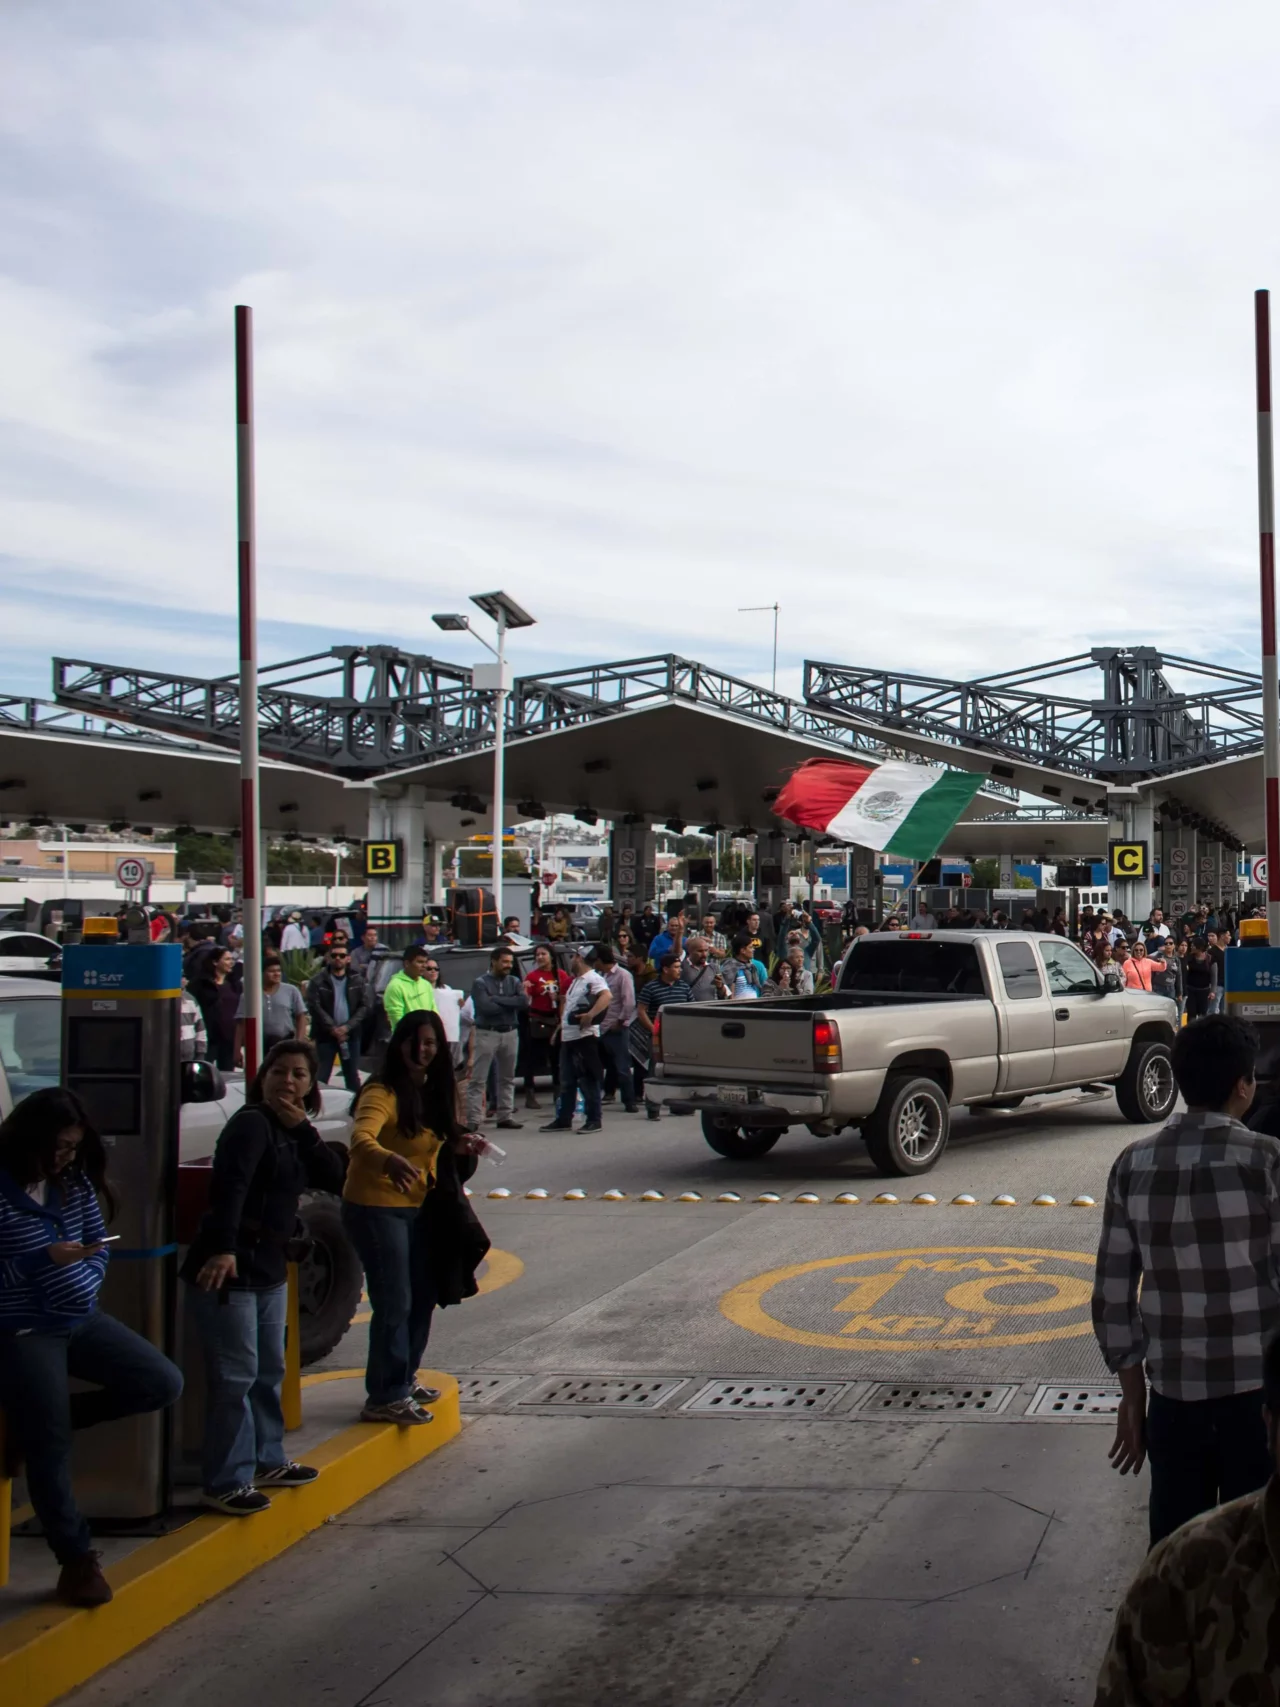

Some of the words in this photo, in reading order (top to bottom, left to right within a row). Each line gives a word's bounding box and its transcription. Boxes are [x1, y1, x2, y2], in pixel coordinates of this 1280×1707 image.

[371, 848, 392, 870] B
[1117, 848, 1139, 872] C
[123, 865, 138, 876] 10
[99, 974, 124, 982] SAT
[895, 1257, 1046, 1274] MAX
[832, 1271, 1094, 1316] 10
[839, 1314, 999, 1336] KPH
